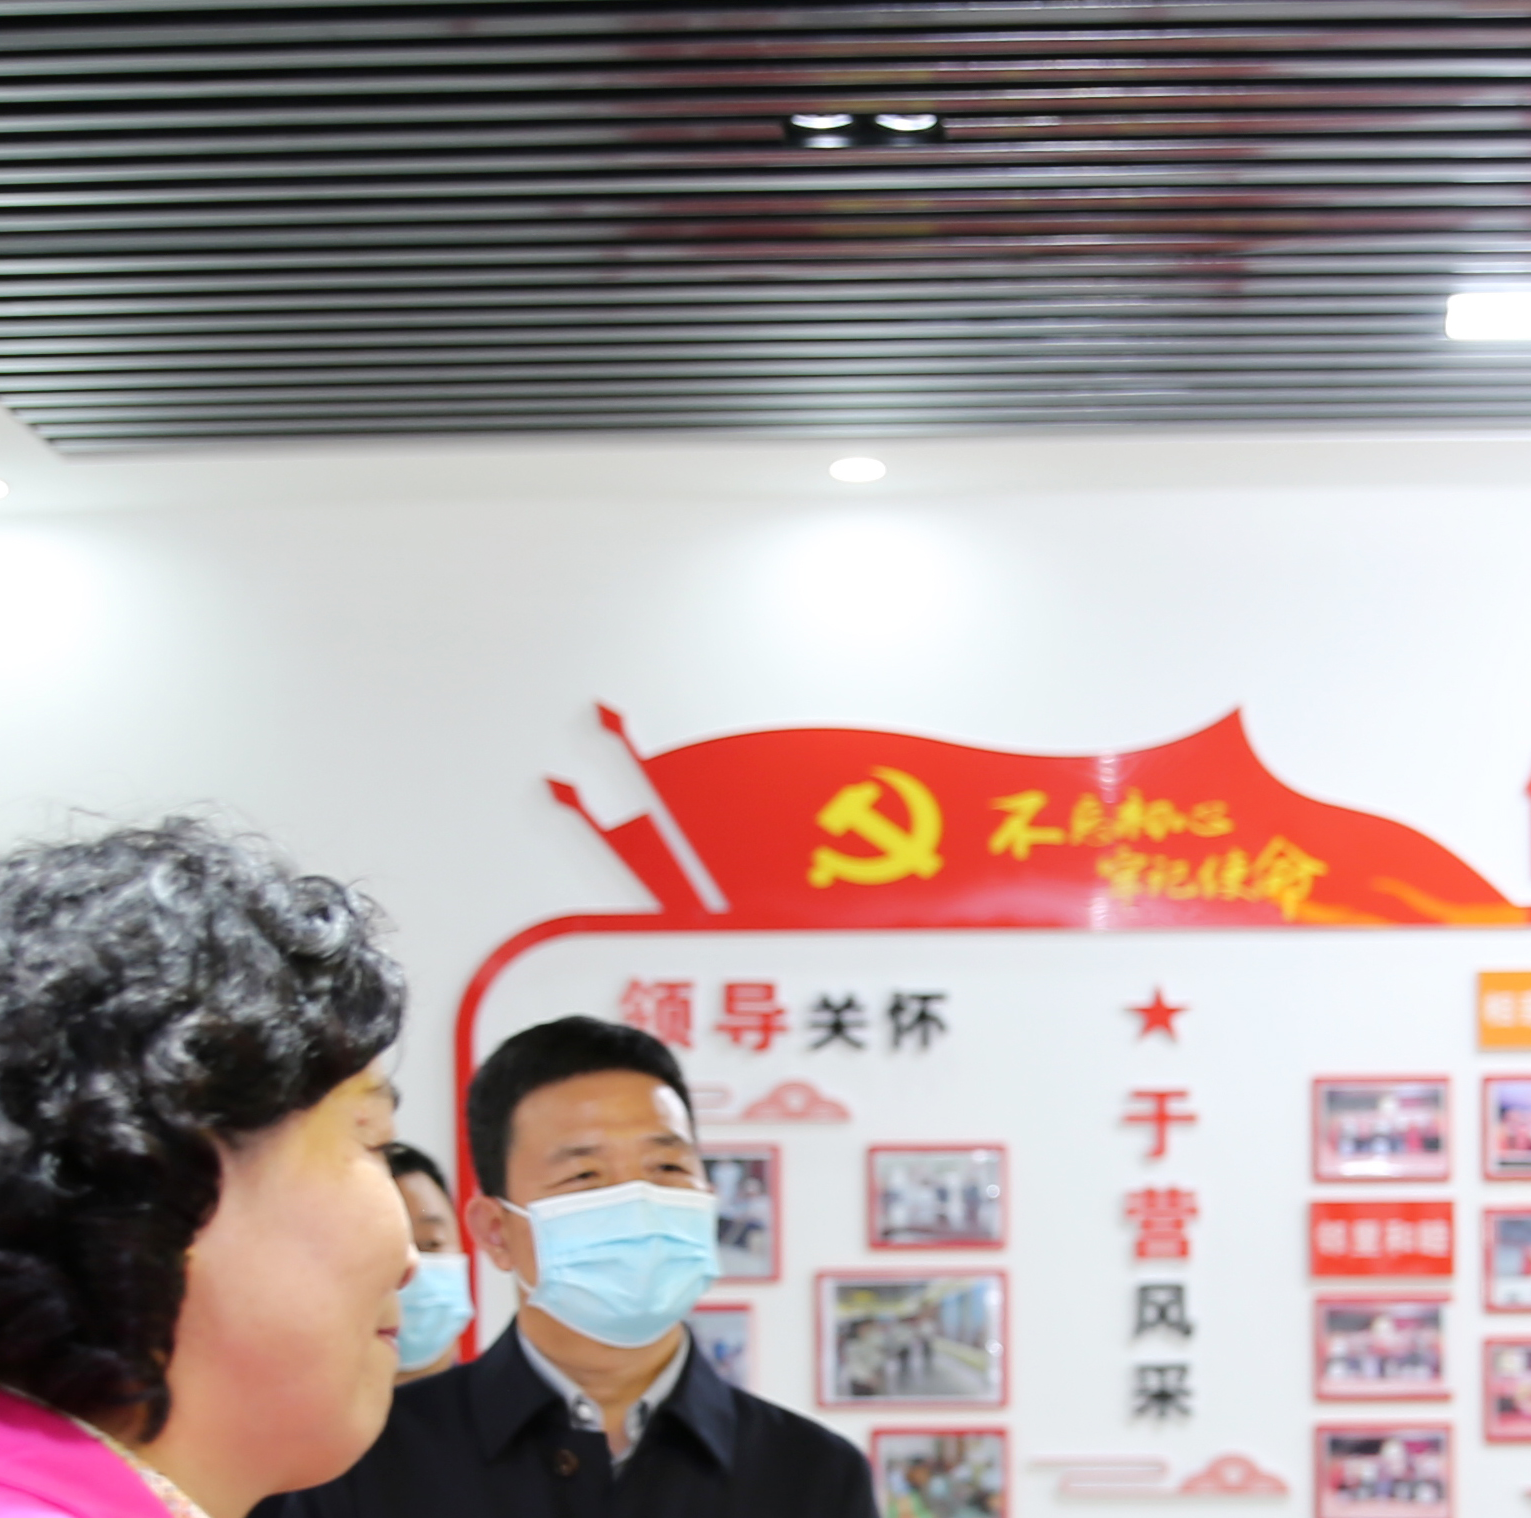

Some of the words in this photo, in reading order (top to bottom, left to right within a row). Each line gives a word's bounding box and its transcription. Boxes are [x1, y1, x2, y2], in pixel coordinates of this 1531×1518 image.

[618, 977, 948, 1052] 领导关怀
[1123, 1088, 1200, 1420] 于营风采
